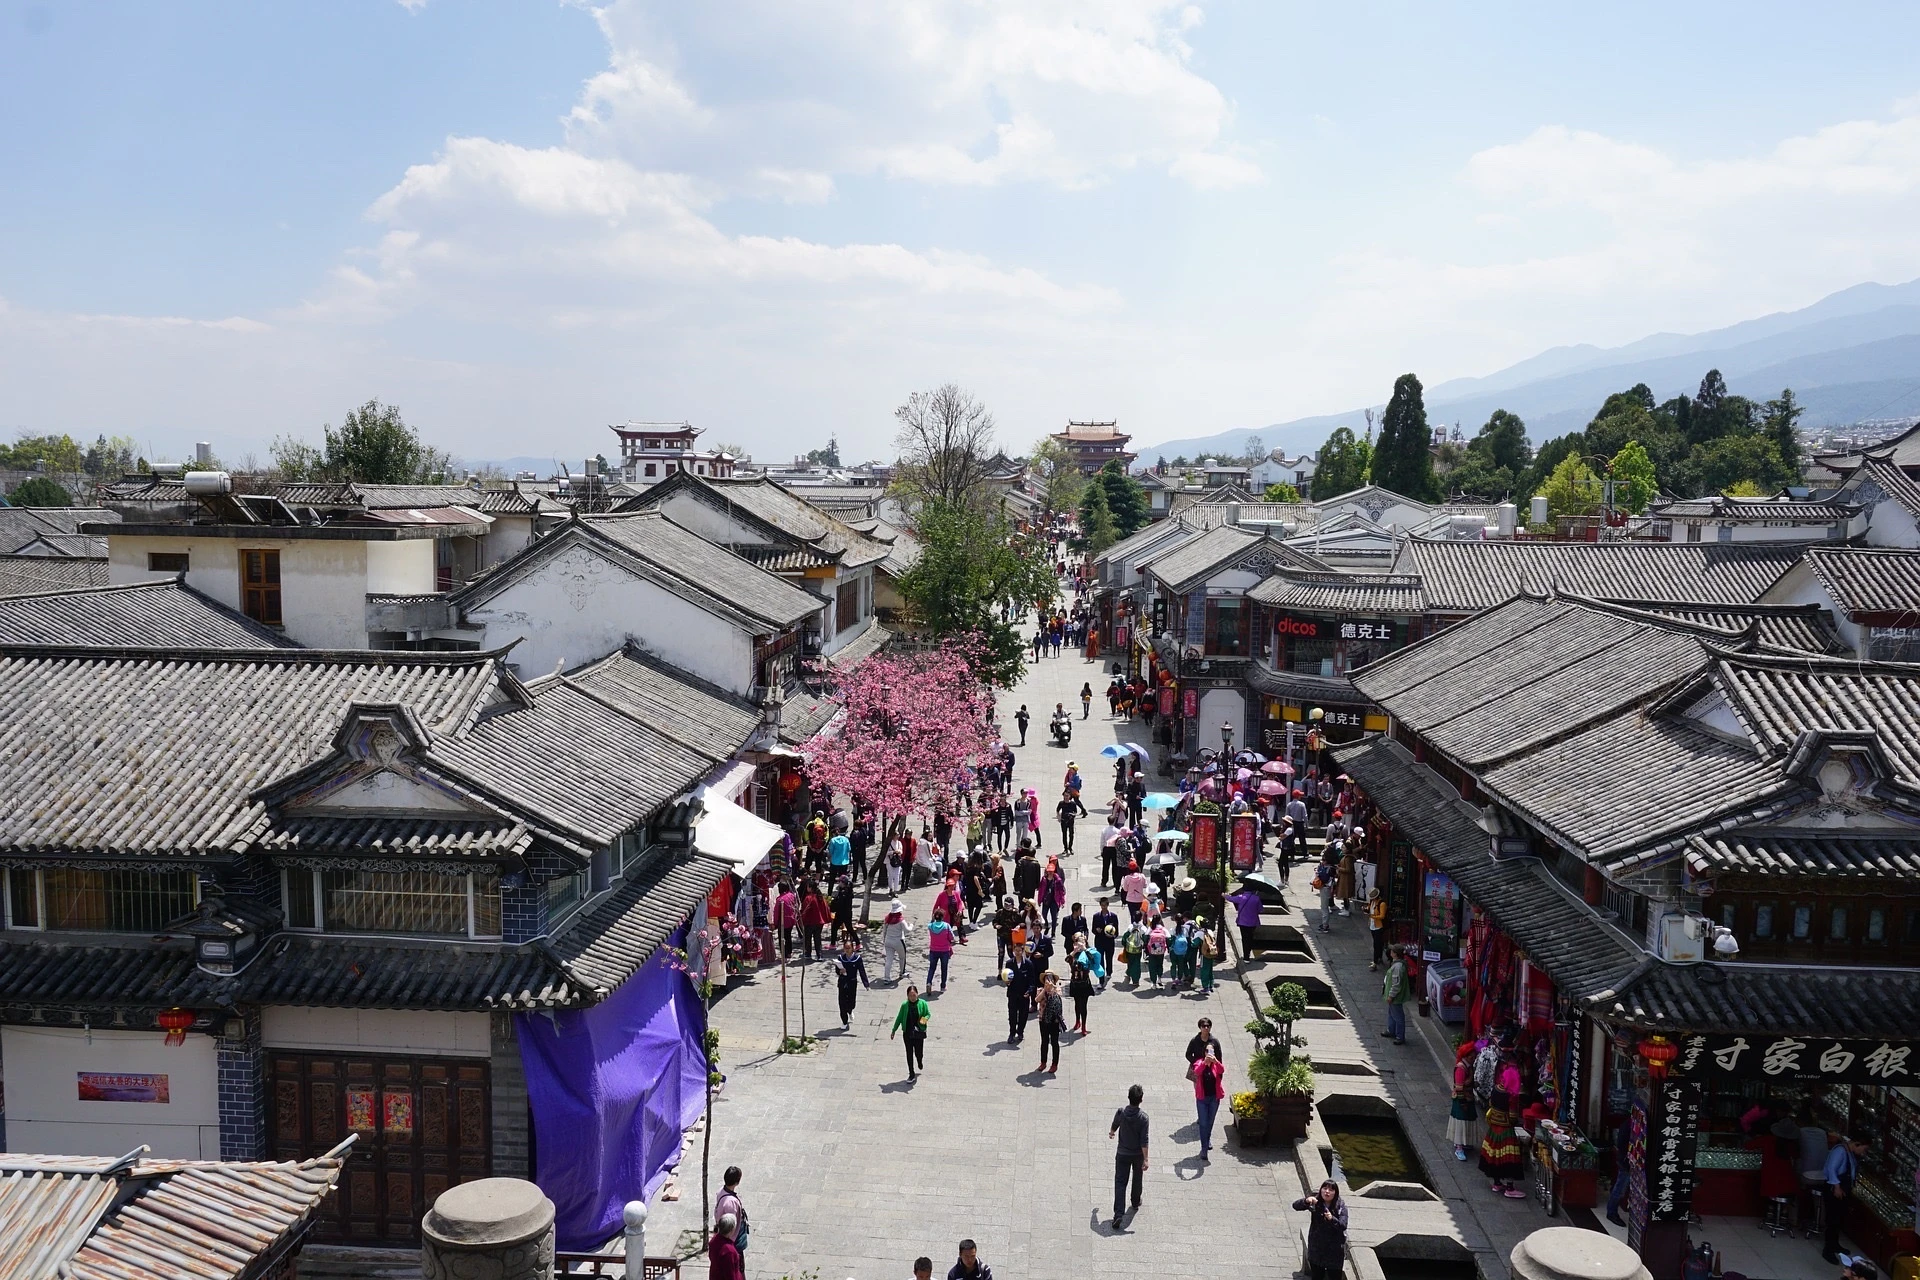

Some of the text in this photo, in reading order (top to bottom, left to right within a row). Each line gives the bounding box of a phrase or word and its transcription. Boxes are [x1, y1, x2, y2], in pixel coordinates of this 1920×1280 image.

[1156, 612, 1164, 636] 德克士
[1278, 618, 1317, 636] dicos
[1340, 622, 1391, 640] 德克士
[1324, 711, 1361, 726] 德克士
[1680, 1035, 1706, 1071] 老字号
[1712, 1036, 1920, 1080] 寸家白银
[1685, 1104, 1699, 1139] 现场加工
[1656, 1087, 1683, 1213] 寸家白银雪花银专卖店
